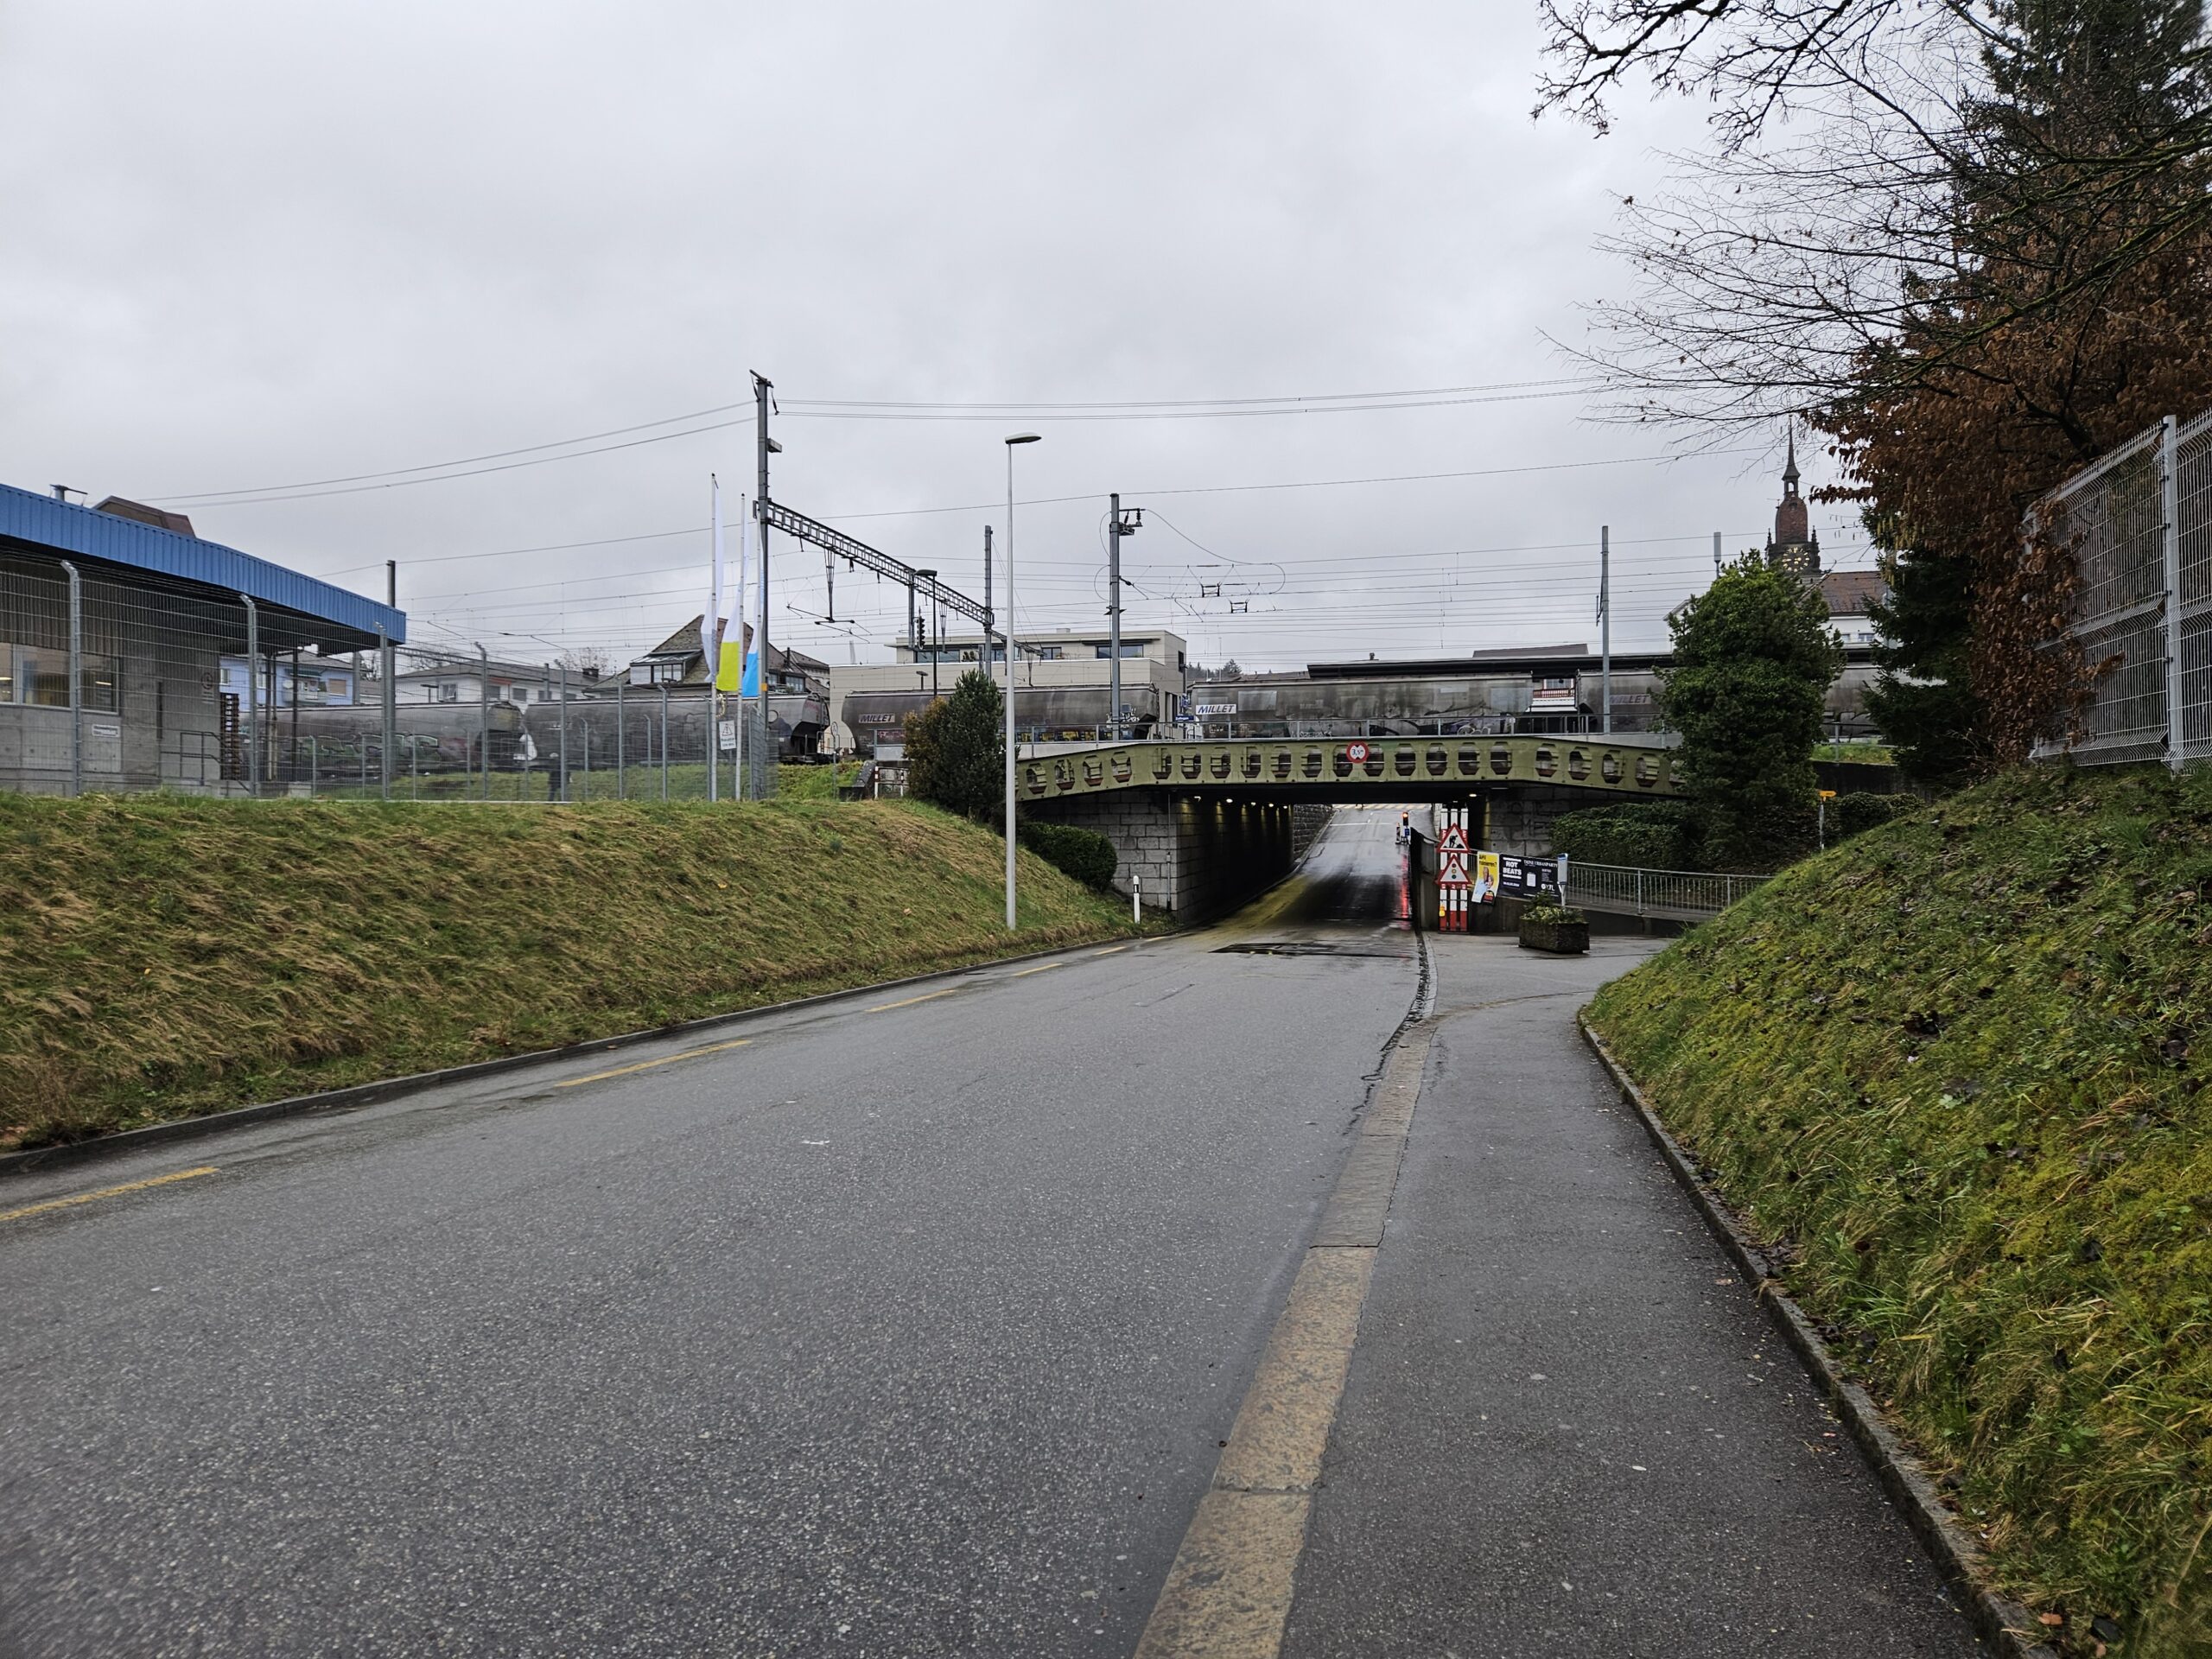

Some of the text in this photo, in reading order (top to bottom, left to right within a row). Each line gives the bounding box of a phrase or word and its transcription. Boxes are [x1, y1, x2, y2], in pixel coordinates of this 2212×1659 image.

[1610, 695, 1649, 704] MILLET
[1198, 705, 1235, 714] MILLET
[860, 714, 894, 722] MILLET
[1503, 867, 1522, 876] BEATS
